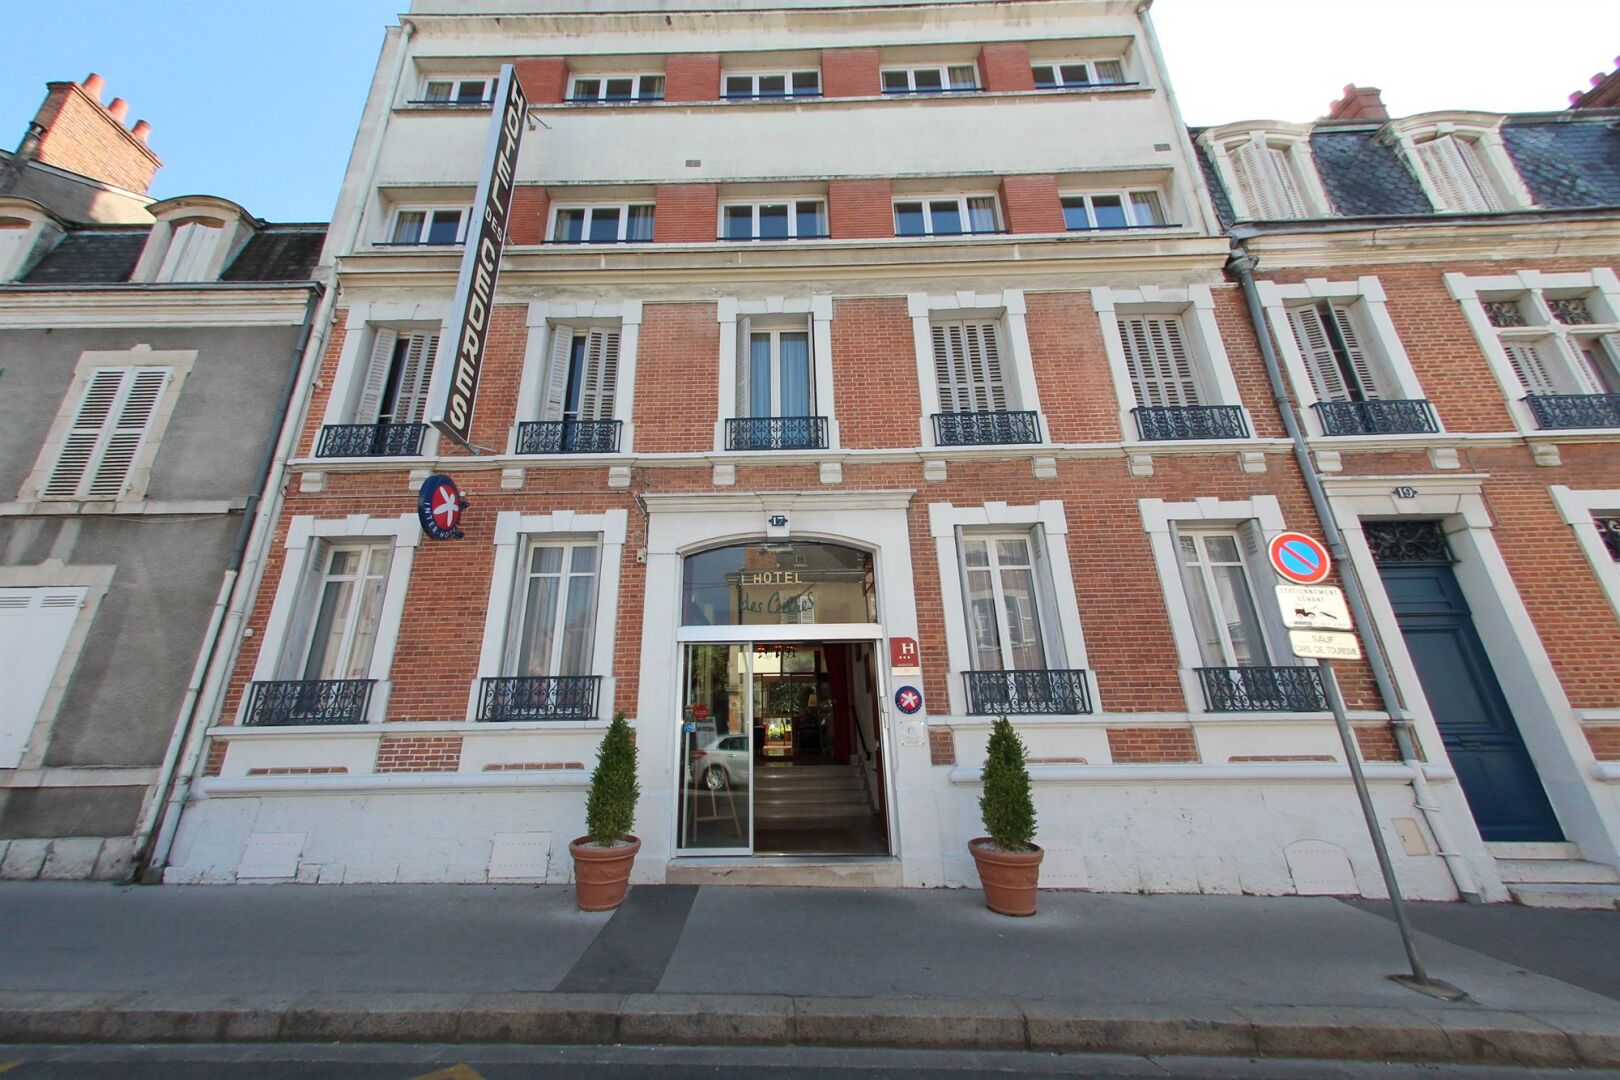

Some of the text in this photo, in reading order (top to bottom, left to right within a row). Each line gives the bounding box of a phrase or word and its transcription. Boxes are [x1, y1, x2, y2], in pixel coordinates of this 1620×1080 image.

[450, 80, 523, 430] HOTEL DES CEDRES
[1398, 488, 1413, 497] 19
[773, 516, 784, 525] 17
[753, 571, 802, 584] HOTEL
[1311, 635, 1334, 643] SAUF
[901, 643, 915, 654] H
[1314, 646, 1325, 654] DE
